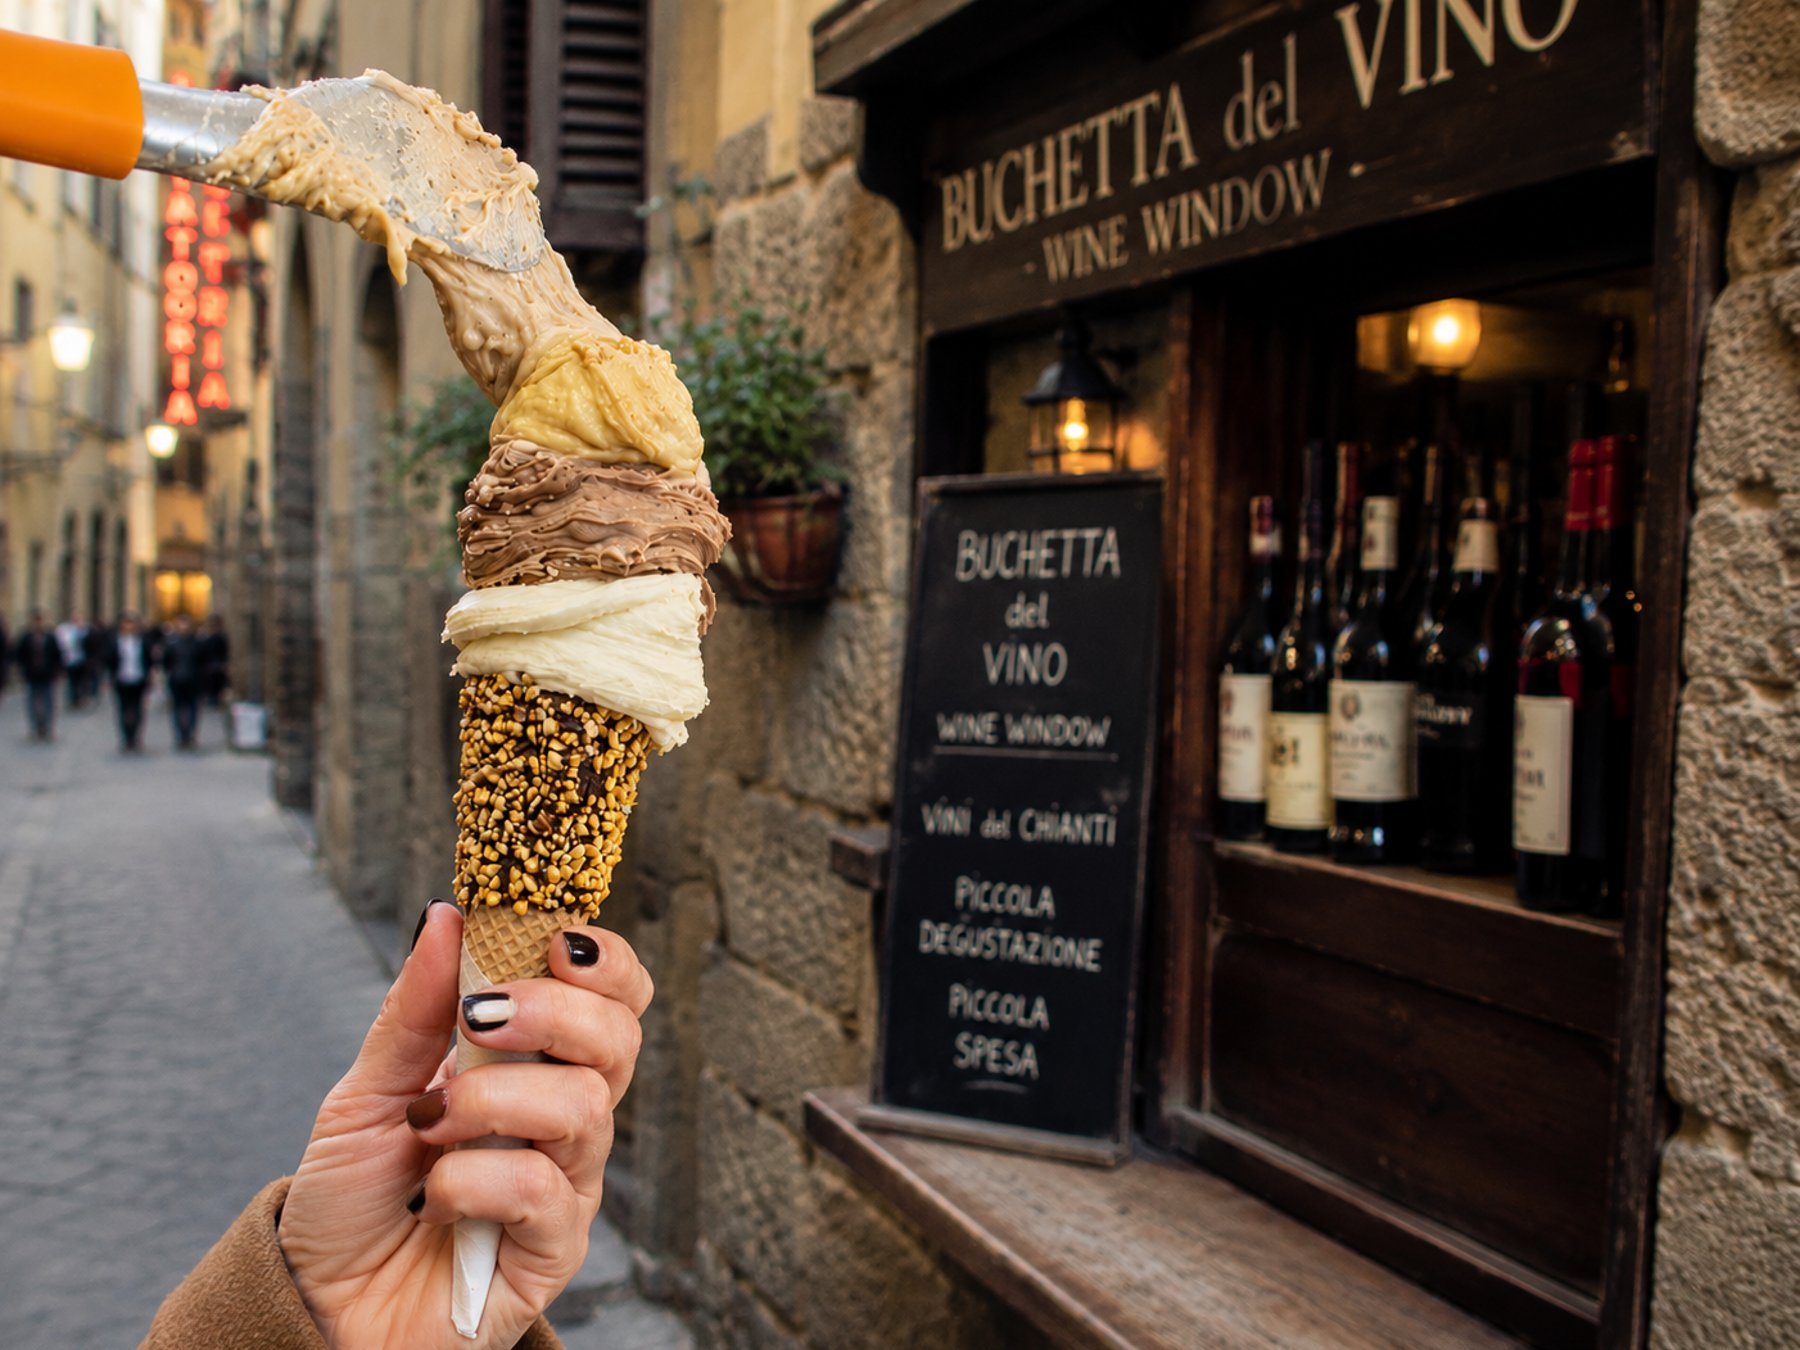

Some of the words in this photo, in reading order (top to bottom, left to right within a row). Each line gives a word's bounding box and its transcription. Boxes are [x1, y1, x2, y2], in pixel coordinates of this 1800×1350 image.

[941, 81, 1198, 253] BUCHETTA
[1224, 33, 1301, 150] del
[1042, 213, 1129, 283] WINE
[1141, 147, 1333, 256] WINDOW
[955, 526, 1121, 582] BUCHETTA
[1005, 590, 1050, 629] del
[982, 641, 1068, 687] VINO
[936, 711, 1000, 744] WINE
[1003, 712, 1112, 748] WINDOW
[955, 874, 1056, 920] PICCOLA
[918, 919, 1104, 973] DEGUSTAZIONE
[948, 983, 1050, 1031] PICCOLA
[953, 1031, 1041, 1080] SPESA
